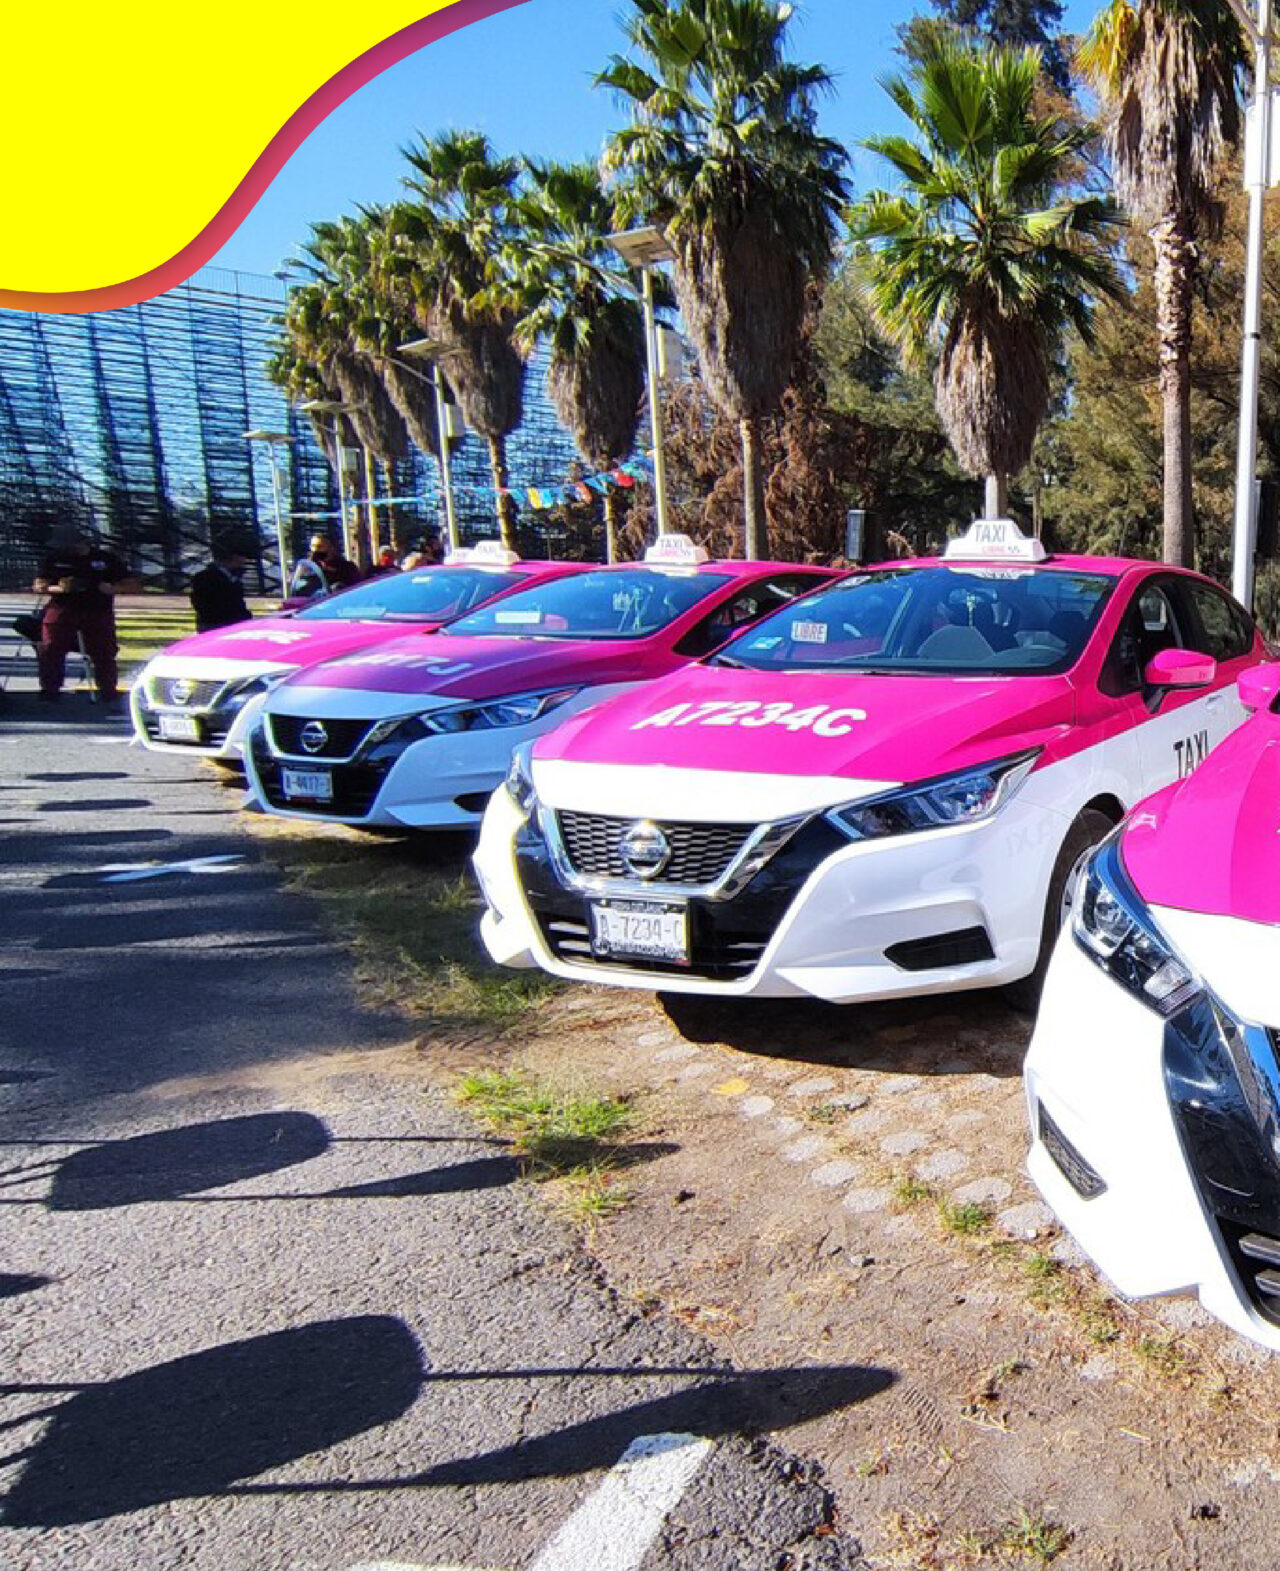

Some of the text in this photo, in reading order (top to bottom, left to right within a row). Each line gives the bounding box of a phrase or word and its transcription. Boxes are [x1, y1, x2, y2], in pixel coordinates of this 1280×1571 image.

[974, 524, 1006, 542] TAXI
[630, 700, 867, 737] A7234C
[1173, 729, 1208, 779] TAXI
